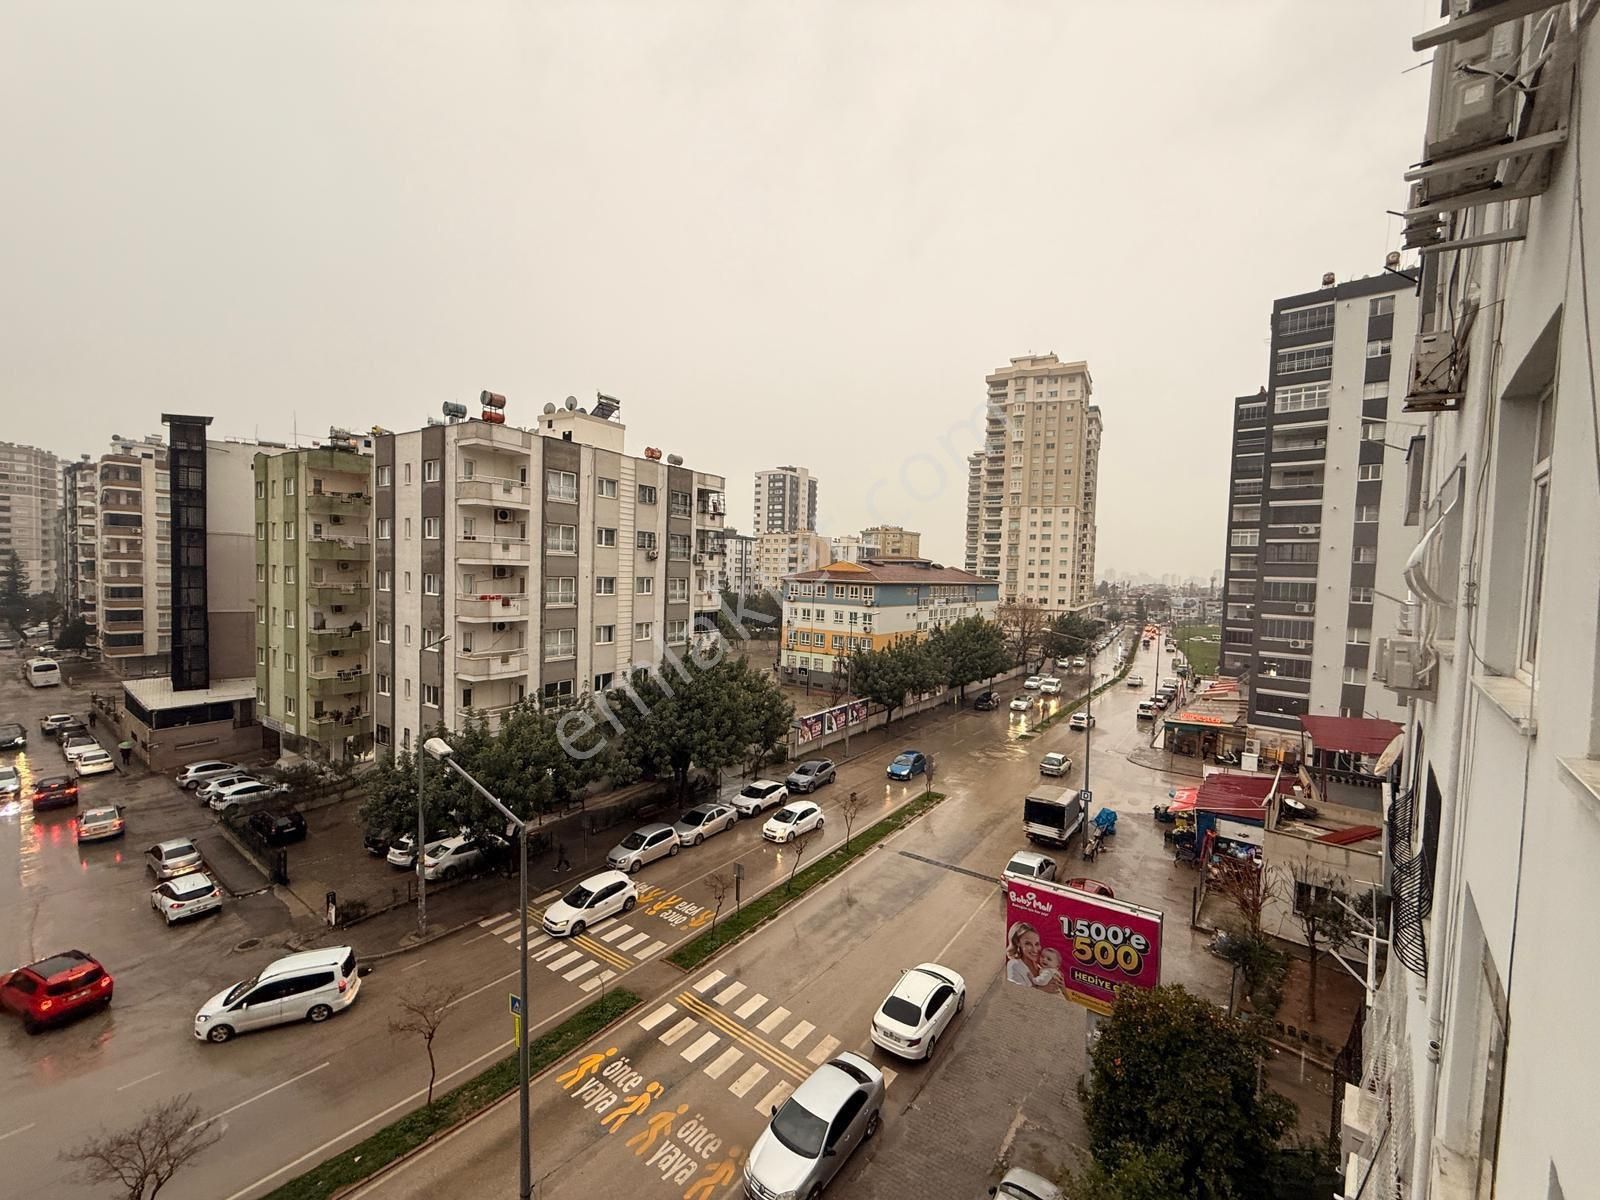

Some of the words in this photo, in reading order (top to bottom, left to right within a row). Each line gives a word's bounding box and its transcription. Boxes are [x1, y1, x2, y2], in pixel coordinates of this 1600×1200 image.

[674, 901, 705, 917] yaya
[1009, 891, 1031, 907] Baby
[659, 909, 688, 927] önce
[1072, 936, 1140, 972] 500
[1074, 970, 1111, 990] HEDİYE
[602, 1056, 643, 1093] önce
[570, 1077, 618, 1114] yaya
[676, 1113, 722, 1160] önce
[645, 1140, 698, 1186] yaya
